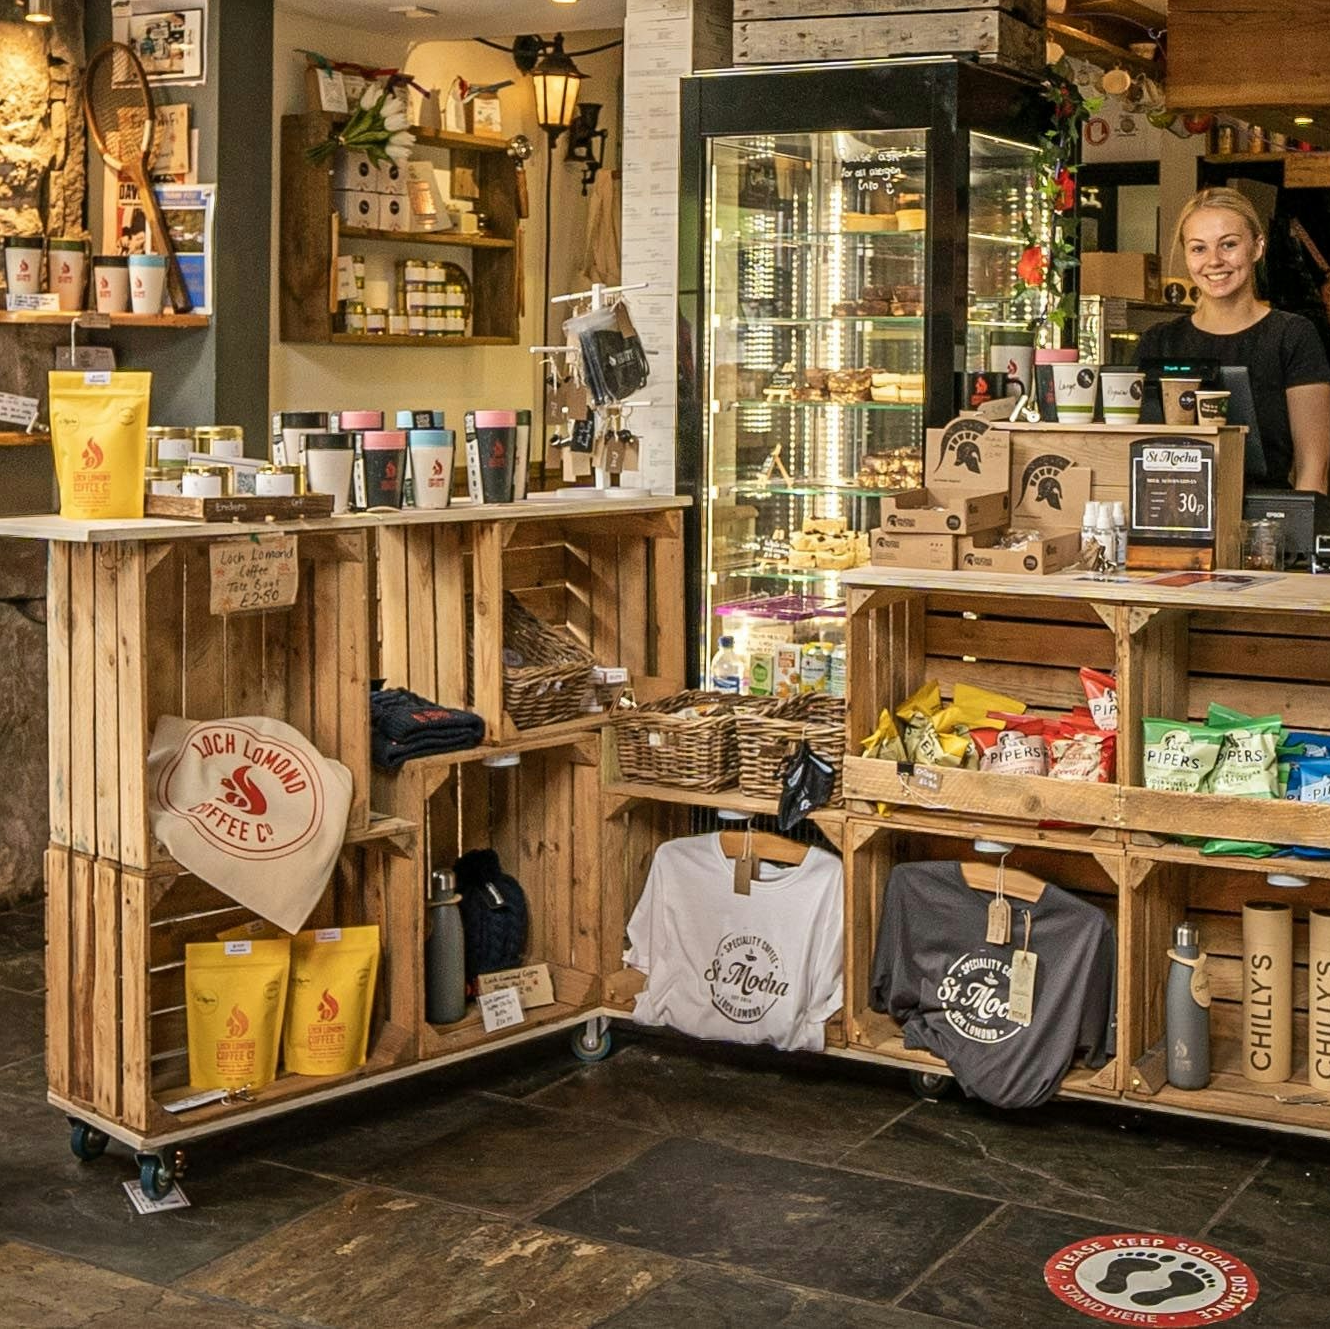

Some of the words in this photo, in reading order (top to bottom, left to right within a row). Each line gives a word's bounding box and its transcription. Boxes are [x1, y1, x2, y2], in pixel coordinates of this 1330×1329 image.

[1146, 451, 1158, 462] St
[1159, 450, 1199, 466] Mocha
[1178, 493, 1204, 515] 30p
[220, 551, 245, 567] Loch
[251, 546, 294, 562] Lomond
[1093, 703, 1117, 716] PIP
[192, 733, 235, 759] LOCH
[243, 739, 307, 795] LOMOND
[990, 747, 1041, 764] PIPERS
[1147, 752, 1200, 770] PIPERS
[724, 936, 761, 953] SPECIALITY
[762, 940, 779, 964] COFFEE
[722, 962, 789, 996] Mocha
[961, 958, 1002, 975] SPECIALITY
[937, 977, 962, 1002] St
[718, 997, 733, 1014] LOCH
[733, 1006, 761, 1018] LOMOND
[1250, 953, 1272, 1071] CHILLY'S
[951, 1010, 966, 1028] OCH
[965, 1023, 998, 1039] LOMOND
[1113, 1238, 1165, 1247] KEEP
[1055, 1241, 1106, 1270] PLEASE
[1175, 1242, 1237, 1272] SOCIAL
[1059, 1283, 1108, 1312] STAND
[1107, 1308, 1158, 1323] HERE
[1196, 1275, 1248, 1320] DISTANCE
